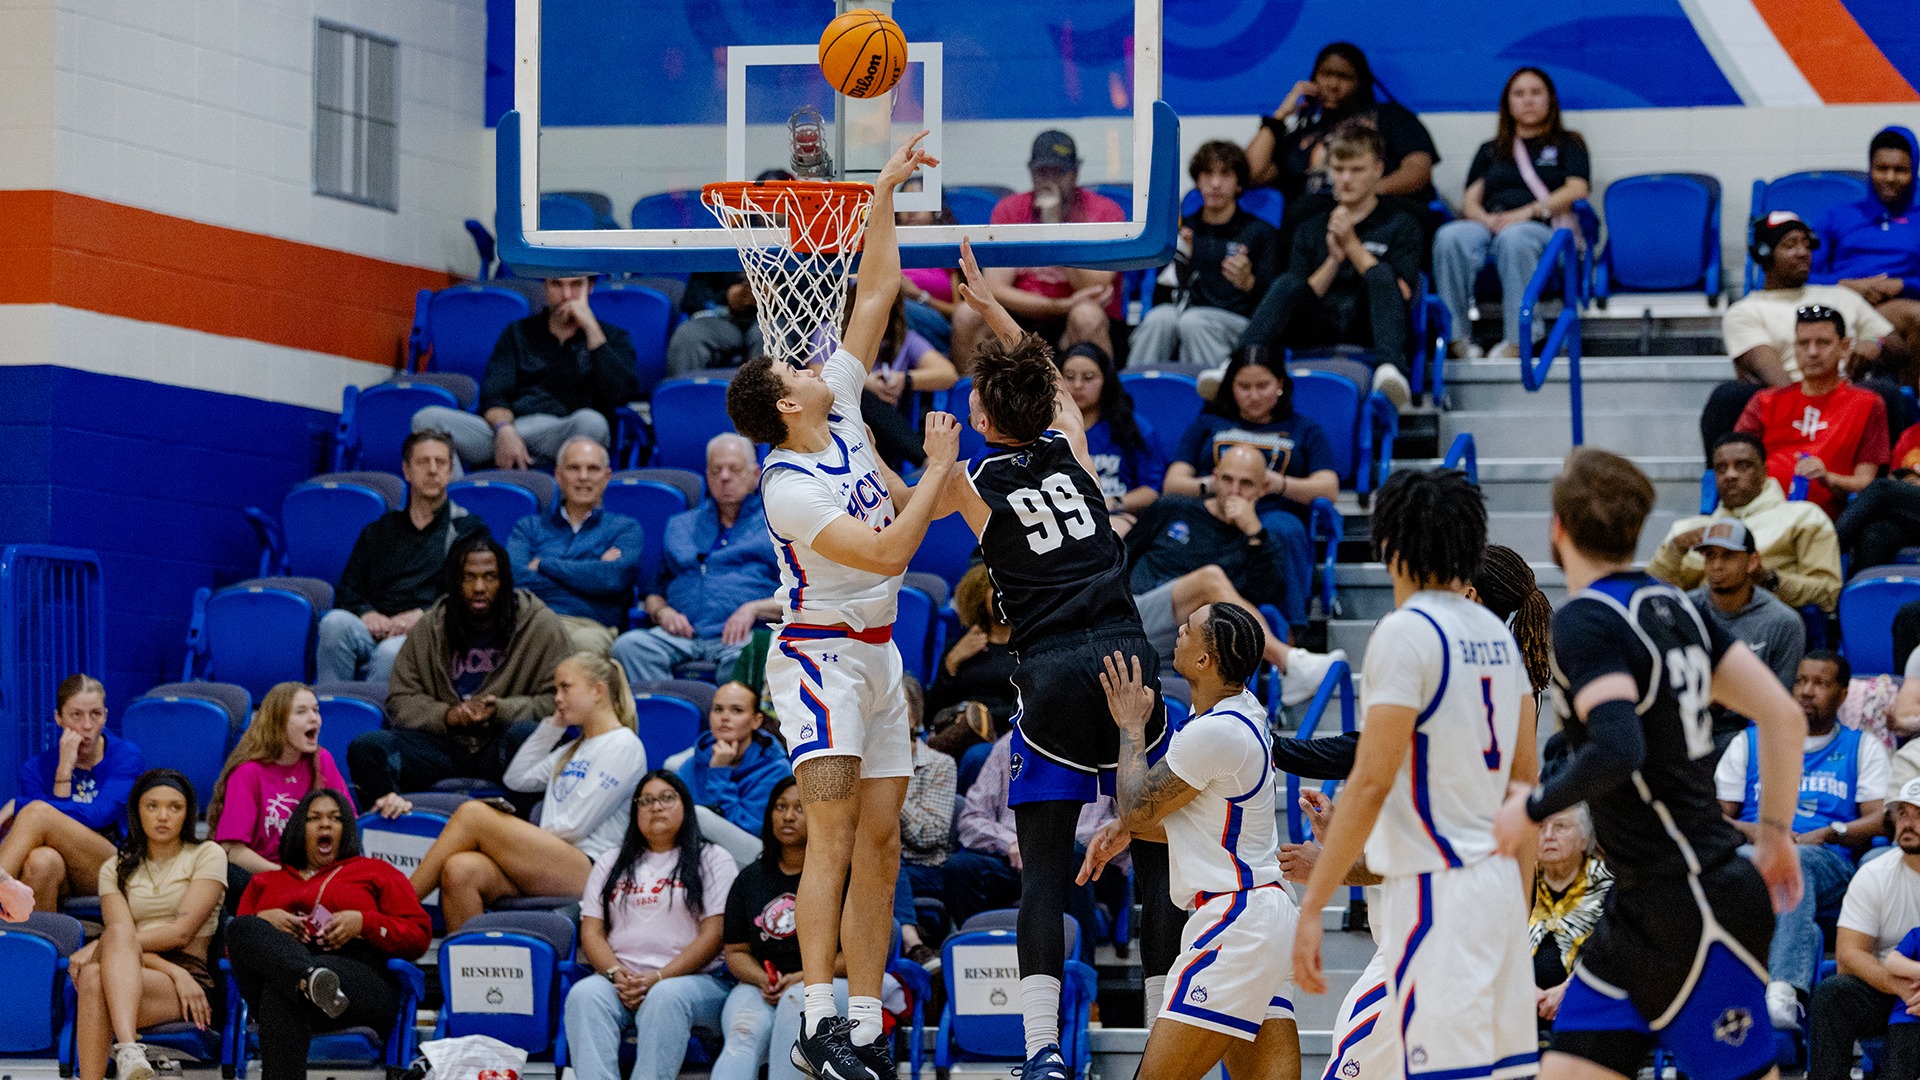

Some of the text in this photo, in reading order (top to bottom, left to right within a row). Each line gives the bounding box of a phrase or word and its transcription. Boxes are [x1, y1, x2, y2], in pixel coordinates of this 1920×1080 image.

[847, 54, 882, 98] Wilson
[1006, 472, 1096, 555] 99
[1480, 676, 1501, 773] 1
[1800, 775, 1848, 800] TEERS
[461, 966, 524, 979] RESERVED
[964, 967, 1019, 980] RESERVE
